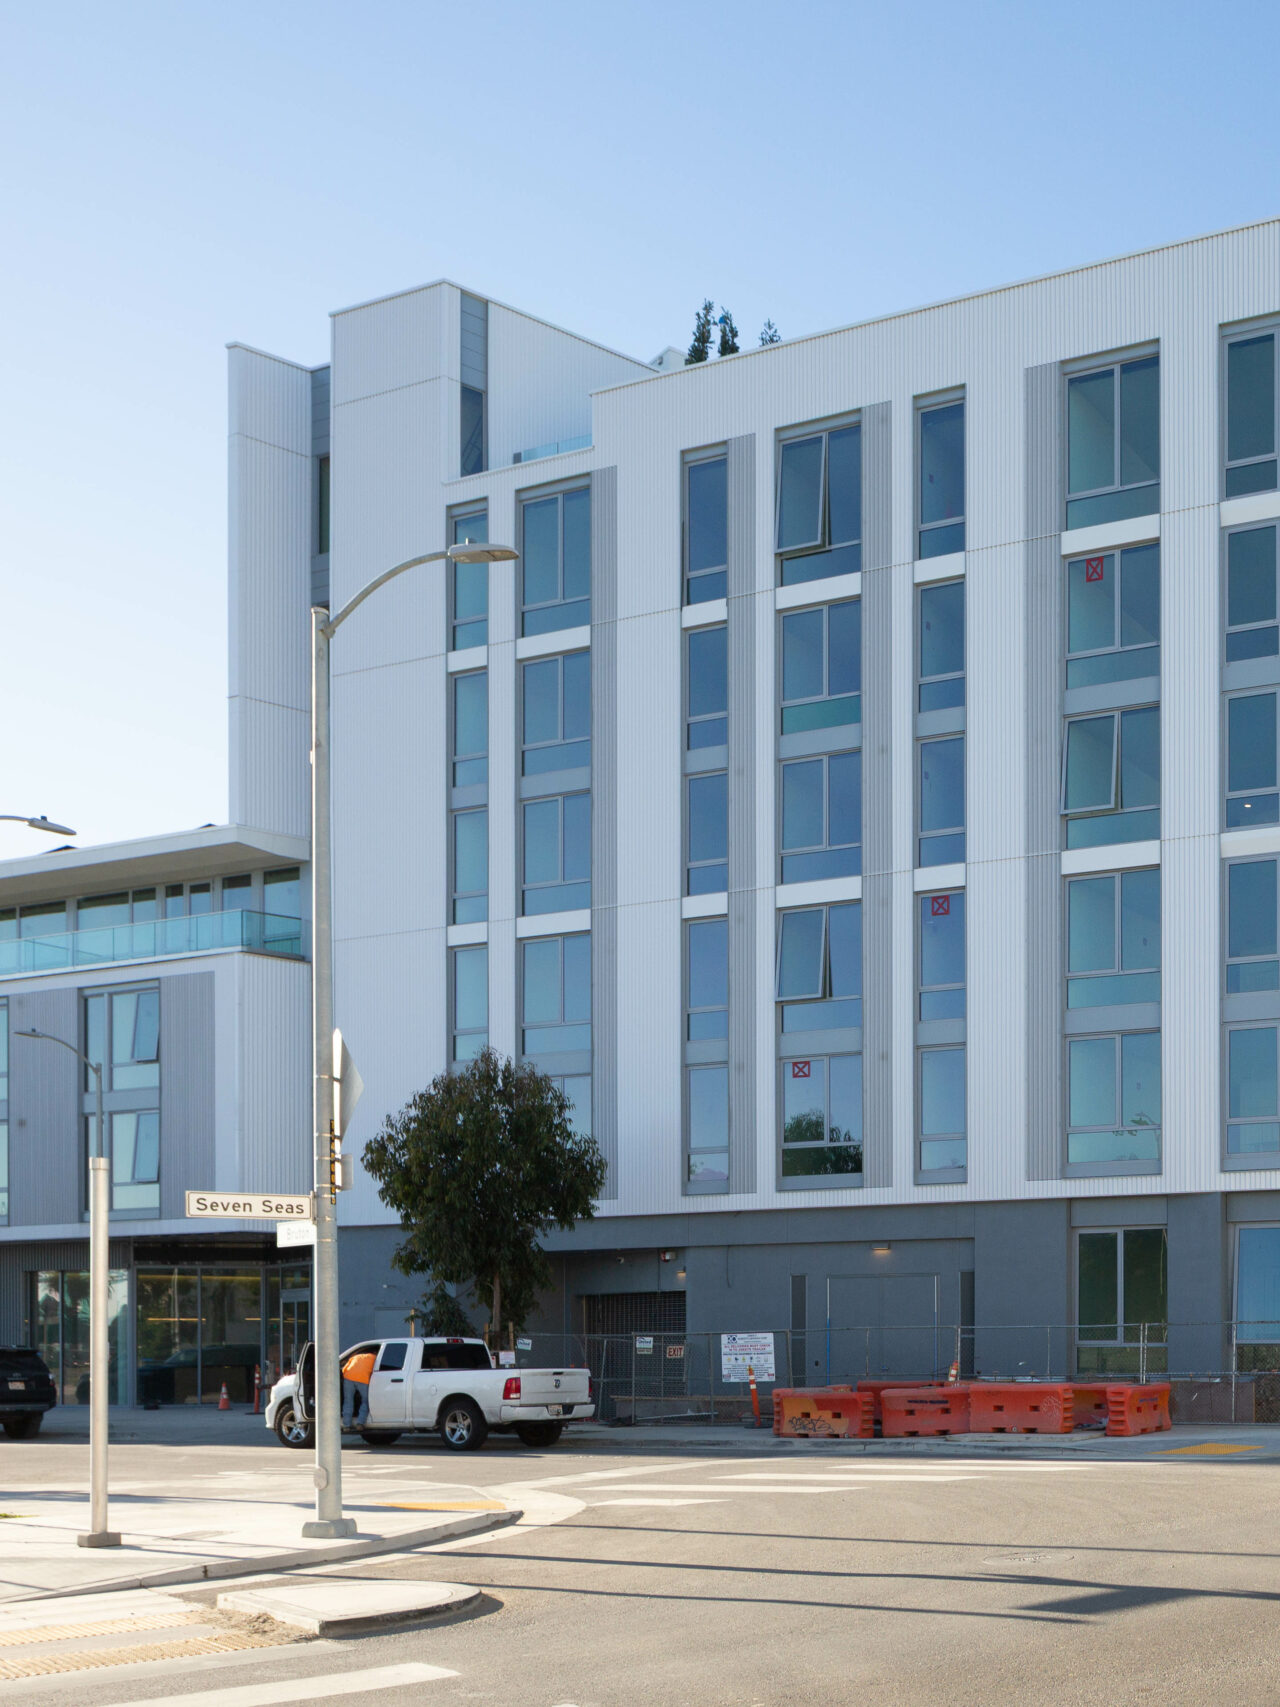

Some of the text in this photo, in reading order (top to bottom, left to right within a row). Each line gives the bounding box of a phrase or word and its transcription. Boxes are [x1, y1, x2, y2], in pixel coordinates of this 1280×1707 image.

[196, 1197, 305, 1214] Seven Seas
[667, 1347, 683, 1357] EXIT
